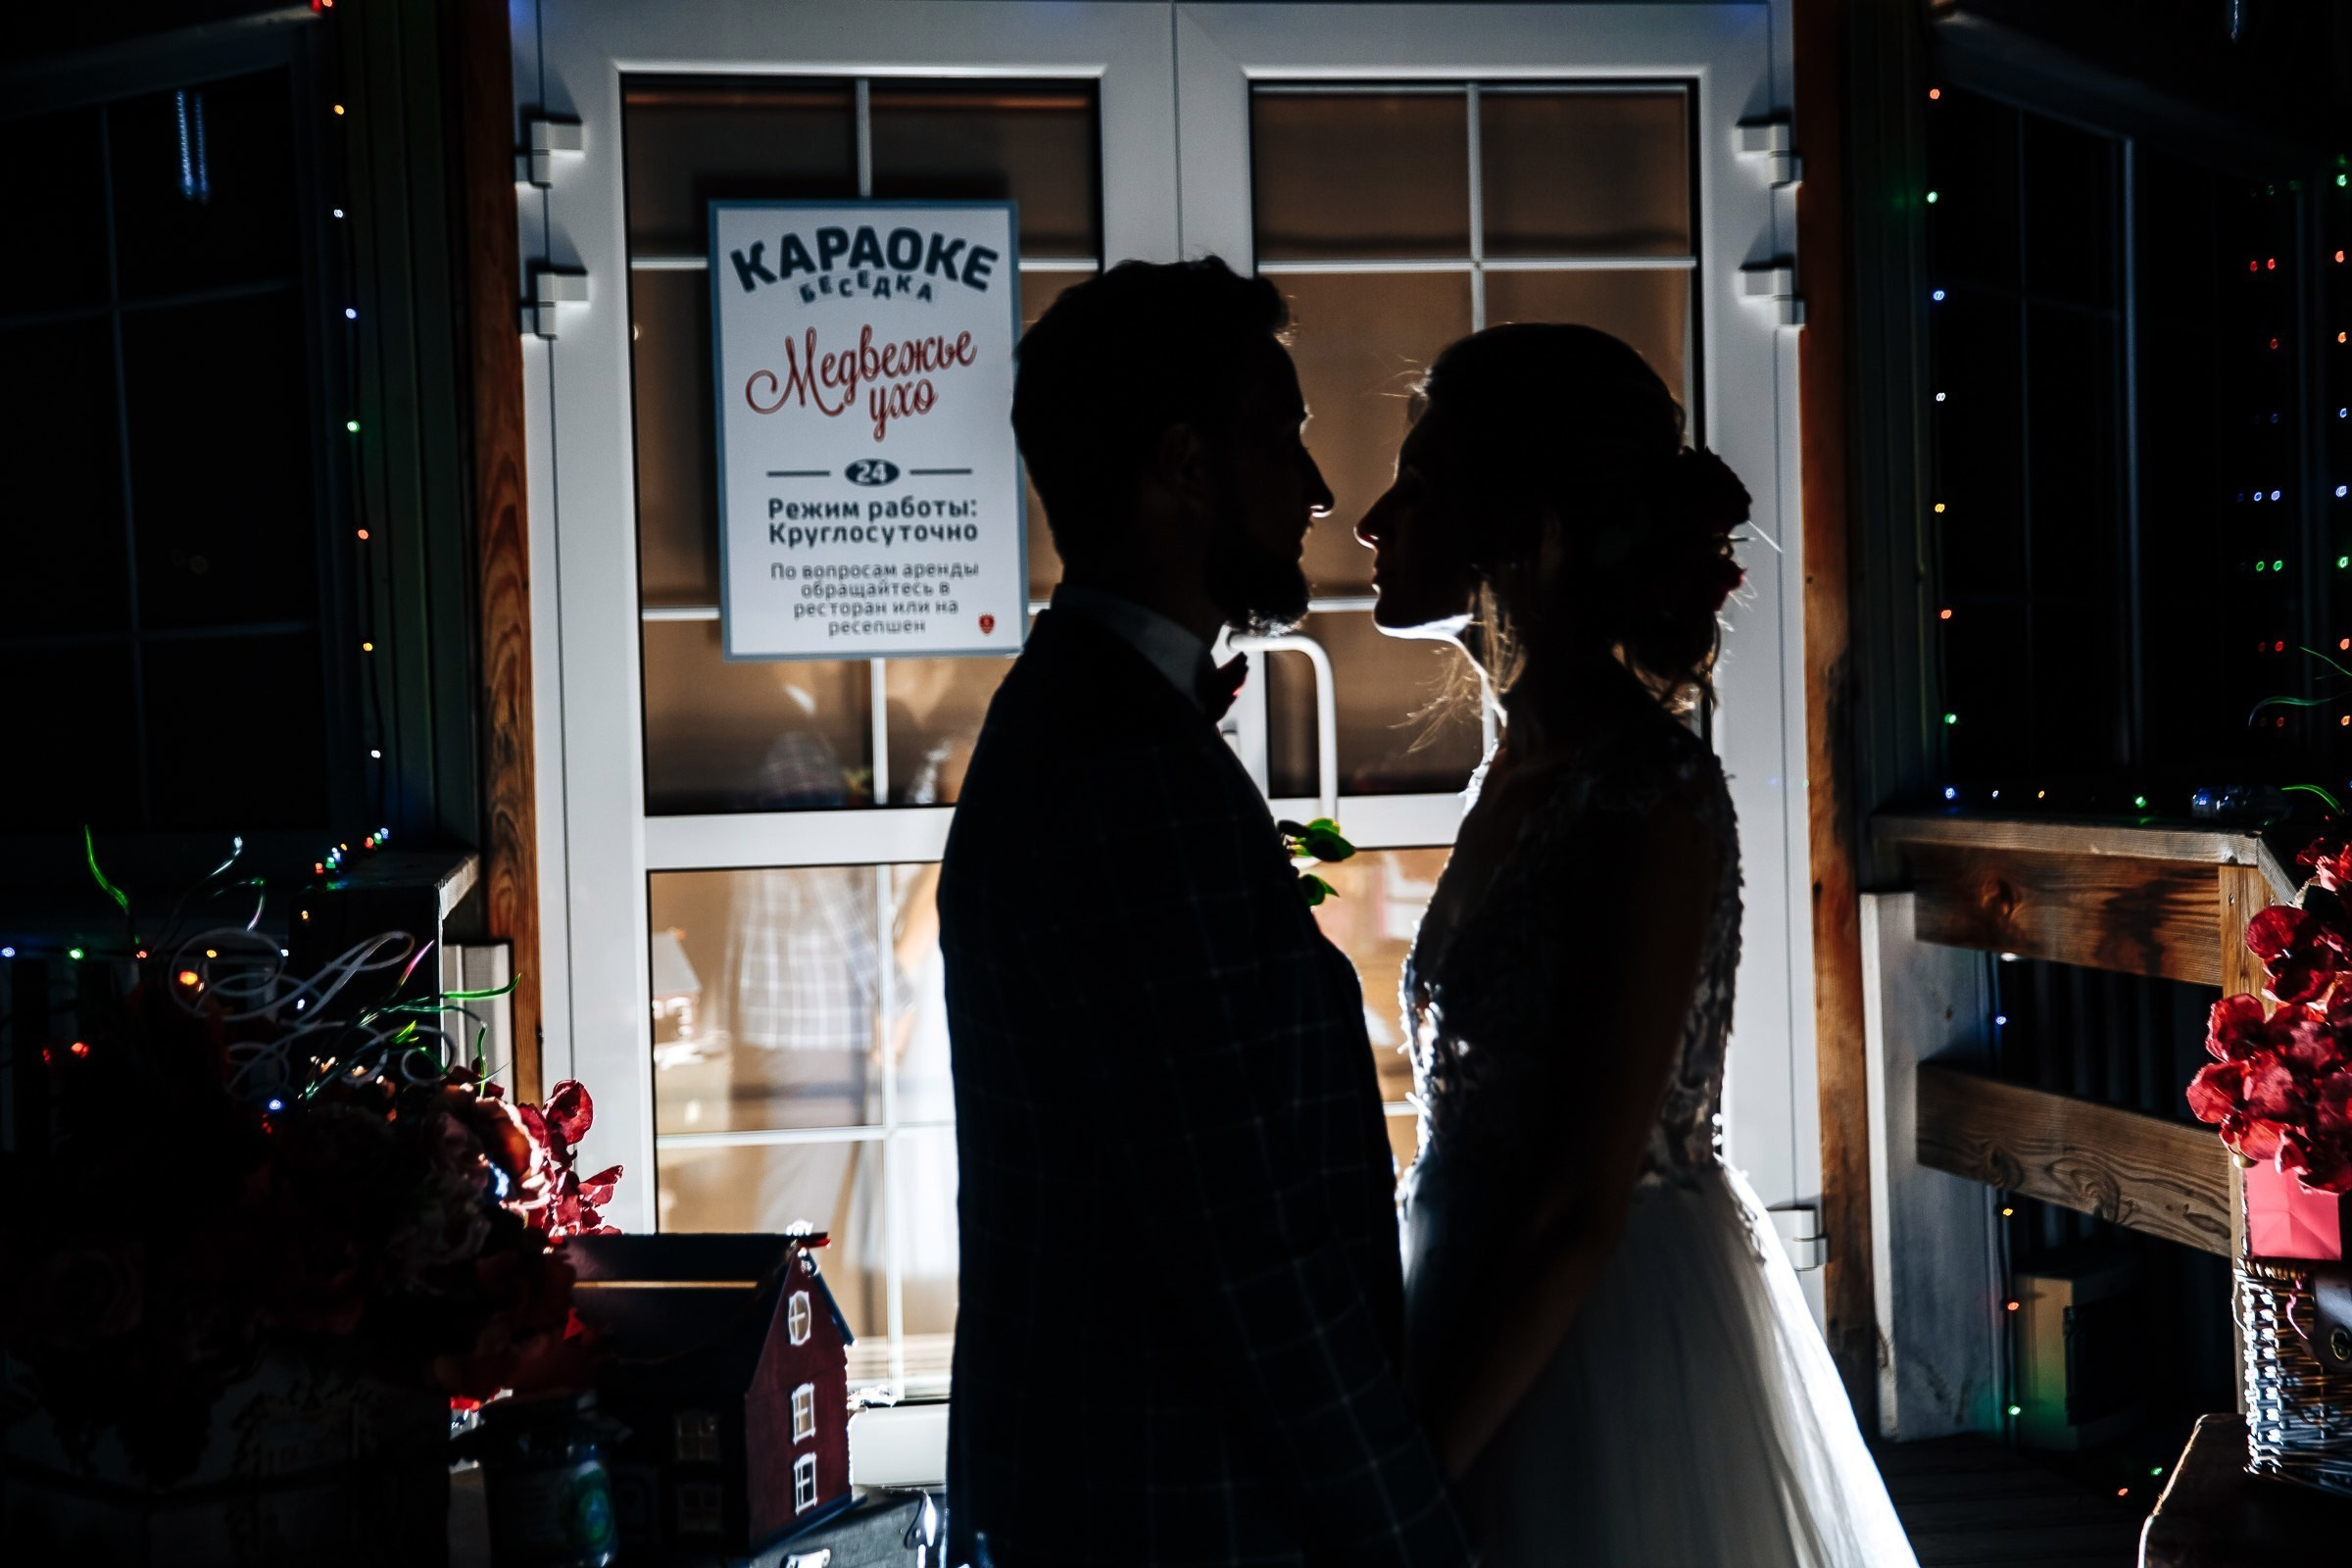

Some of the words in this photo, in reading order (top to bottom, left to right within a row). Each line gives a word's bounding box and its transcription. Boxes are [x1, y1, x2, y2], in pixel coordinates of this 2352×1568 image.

[730, 225, 999, 293] КАРАОКЕ
[799, 270, 933, 304] БЕСЕДКА
[745, 323, 978, 417] Медвежье
[868, 378, 939, 443] ухо
[855, 460, 889, 483] 24
[768, 498, 859, 520] Режим
[868, 496, 977, 522] работы:
[768, 522, 978, 549] Круглосуточно
[770, 562, 797, 580] По
[802, 562, 898, 581] вопросам
[902, 562, 979, 580] аренды
[801, 578, 935, 601] обращайтесь
[938, 581, 951, 597] в
[794, 601, 888, 620] ресторан
[892, 601, 930, 615] или
[935, 600, 959, 615] на
[827, 618, 926, 639] ресепшен
